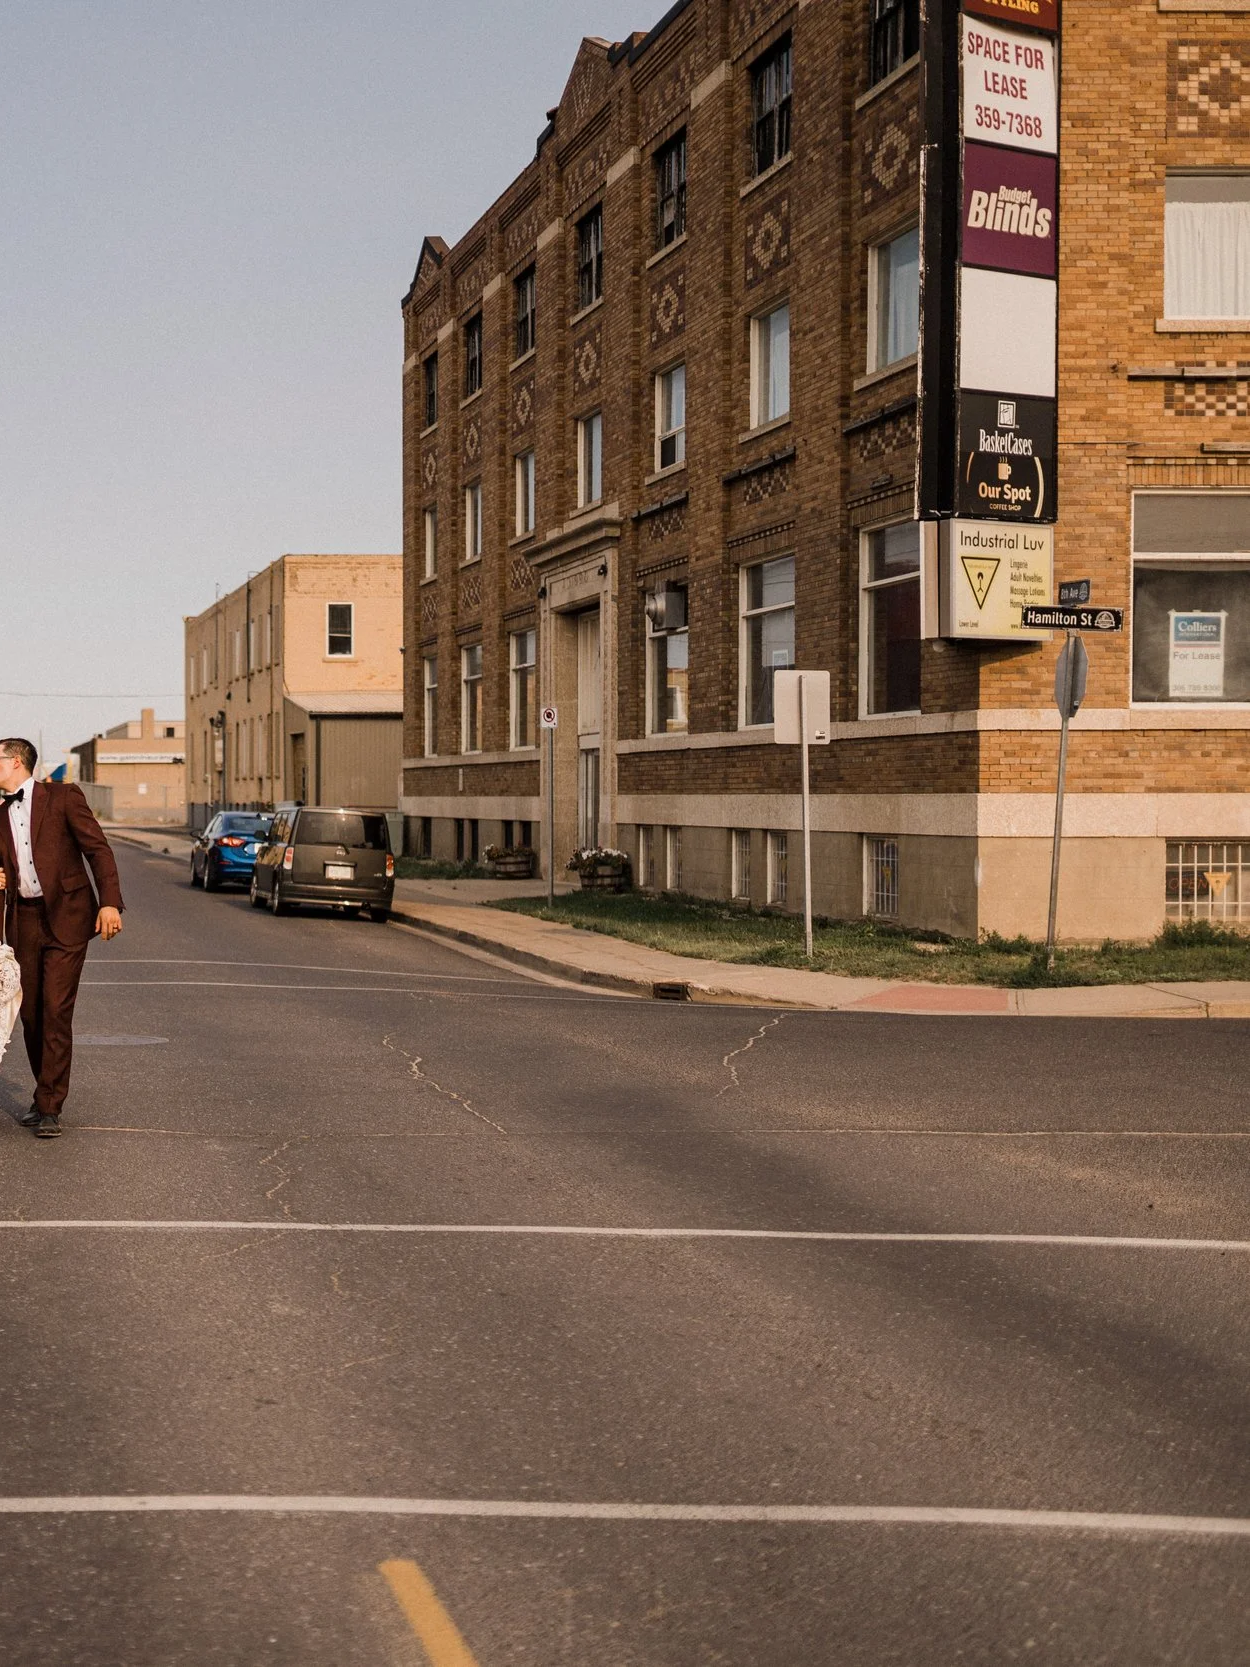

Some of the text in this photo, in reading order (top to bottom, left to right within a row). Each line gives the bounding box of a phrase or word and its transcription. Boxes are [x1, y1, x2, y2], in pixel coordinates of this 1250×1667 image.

[968, 31, 1045, 70] SPACE FOR
[984, 70, 1028, 100] LEASE
[975, 104, 1043, 139] 359-7368
[998, 185, 1032, 204] Budget
[967, 190, 1052, 238] Blinds
[979, 428, 1032, 456] BasketCases
[978, 482, 1031, 504] Our Spot
[960, 530, 1045, 551] Industrial Luv
[1010, 559, 1028, 570] Lingerie
[1010, 572, 1022, 582] Adult
[1070, 587, 1079, 599] Ave
[970, 620, 979, 628] Level
[1027, 611, 1077, 626] Hamilton
[1080, 613, 1092, 626] St
[1178, 621, 1217, 632] Colliers
[1173, 651, 1221, 660] For Lease
